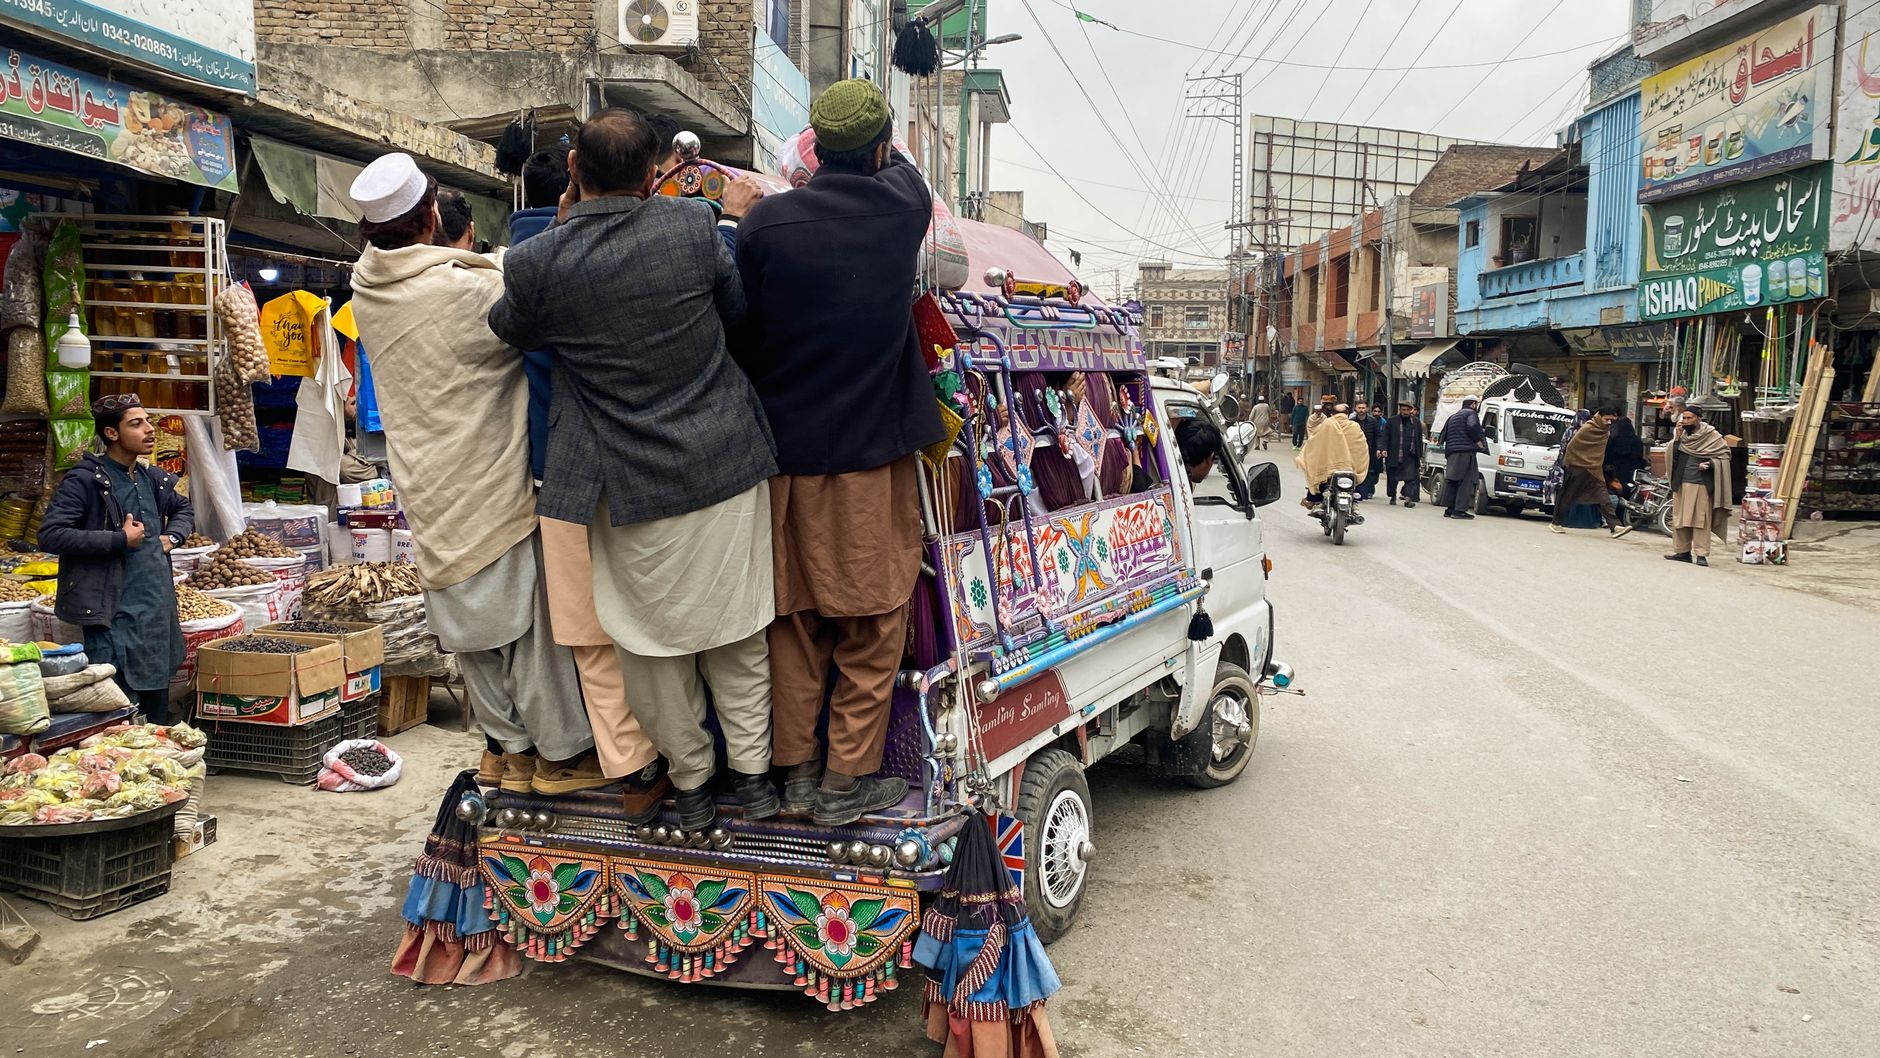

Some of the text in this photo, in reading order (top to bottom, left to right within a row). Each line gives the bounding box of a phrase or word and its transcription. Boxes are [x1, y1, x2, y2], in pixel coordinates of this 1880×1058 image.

[102, 22, 178, 61] 0342-0208631
[1729, 16, 1814, 108] اسحاق
[26, 64, 81, 117] اتفاق
[1763, 178, 1822, 243] اسحاق
[1715, 208, 1762, 258] پینٹ
[1644, 276, 1698, 317] ISHAQ
[1699, 275, 1737, 308] PAINTS
[1100, 332, 1145, 369] NICE
[1507, 409, 1545, 419] Masha
[1020, 691, 1060, 721] Samling
